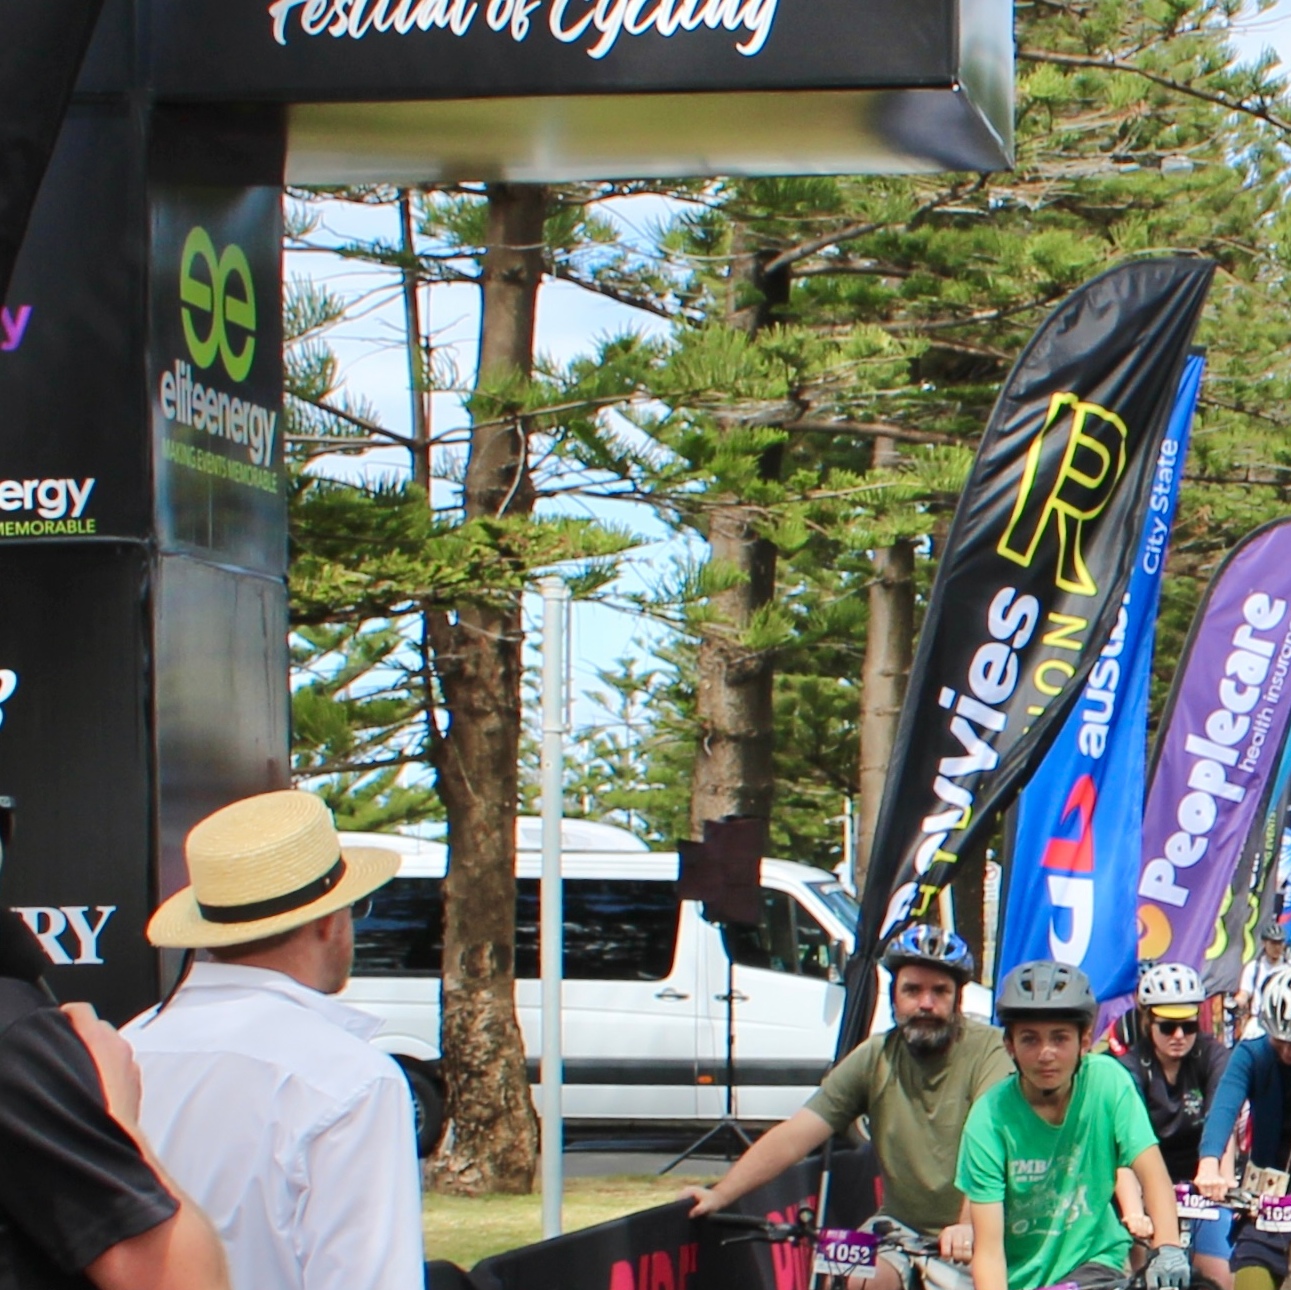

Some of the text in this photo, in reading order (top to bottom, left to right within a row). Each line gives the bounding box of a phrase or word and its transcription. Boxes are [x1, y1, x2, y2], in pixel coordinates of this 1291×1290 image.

[227, 456, 278, 494] MEMORABLE
[1143, 437, 1179, 575] City State
[1137, 591, 1287, 908] Peoplecare
[1237, 707, 1275, 774] health
